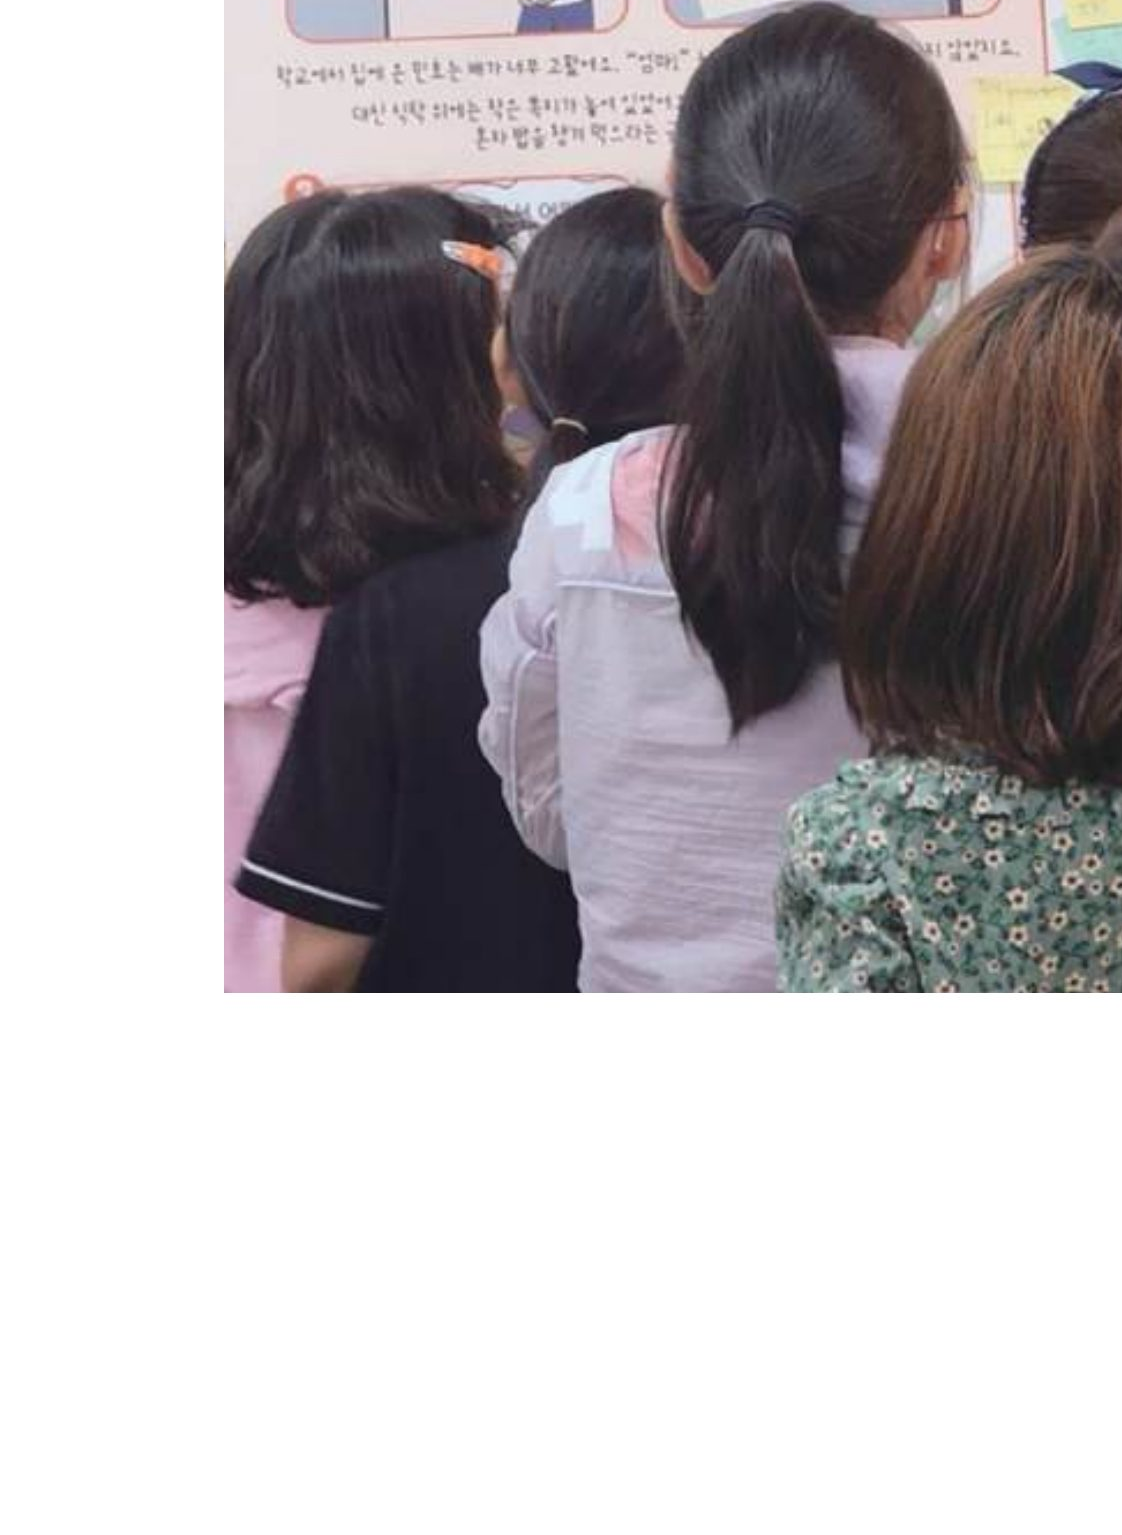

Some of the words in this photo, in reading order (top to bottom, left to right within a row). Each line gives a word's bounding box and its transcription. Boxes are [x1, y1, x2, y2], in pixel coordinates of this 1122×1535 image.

[275, 60, 345, 89] 학교에서
[349, 61, 385, 86] 집에
[411, 59, 462, 85] 민호는
[467, 57, 502, 76] 배가
[505, 56, 542, 75] 너무
[350, 101, 387, 127] 대신
[391, 98, 427, 126] 식탁
[431, 98, 482, 124] 위에는
[488, 96, 521, 123] 작은
[620, 90, 683, 116] 있었어
[476, 125, 508, 151] 혼자
[512, 125, 545, 150] 밥을
